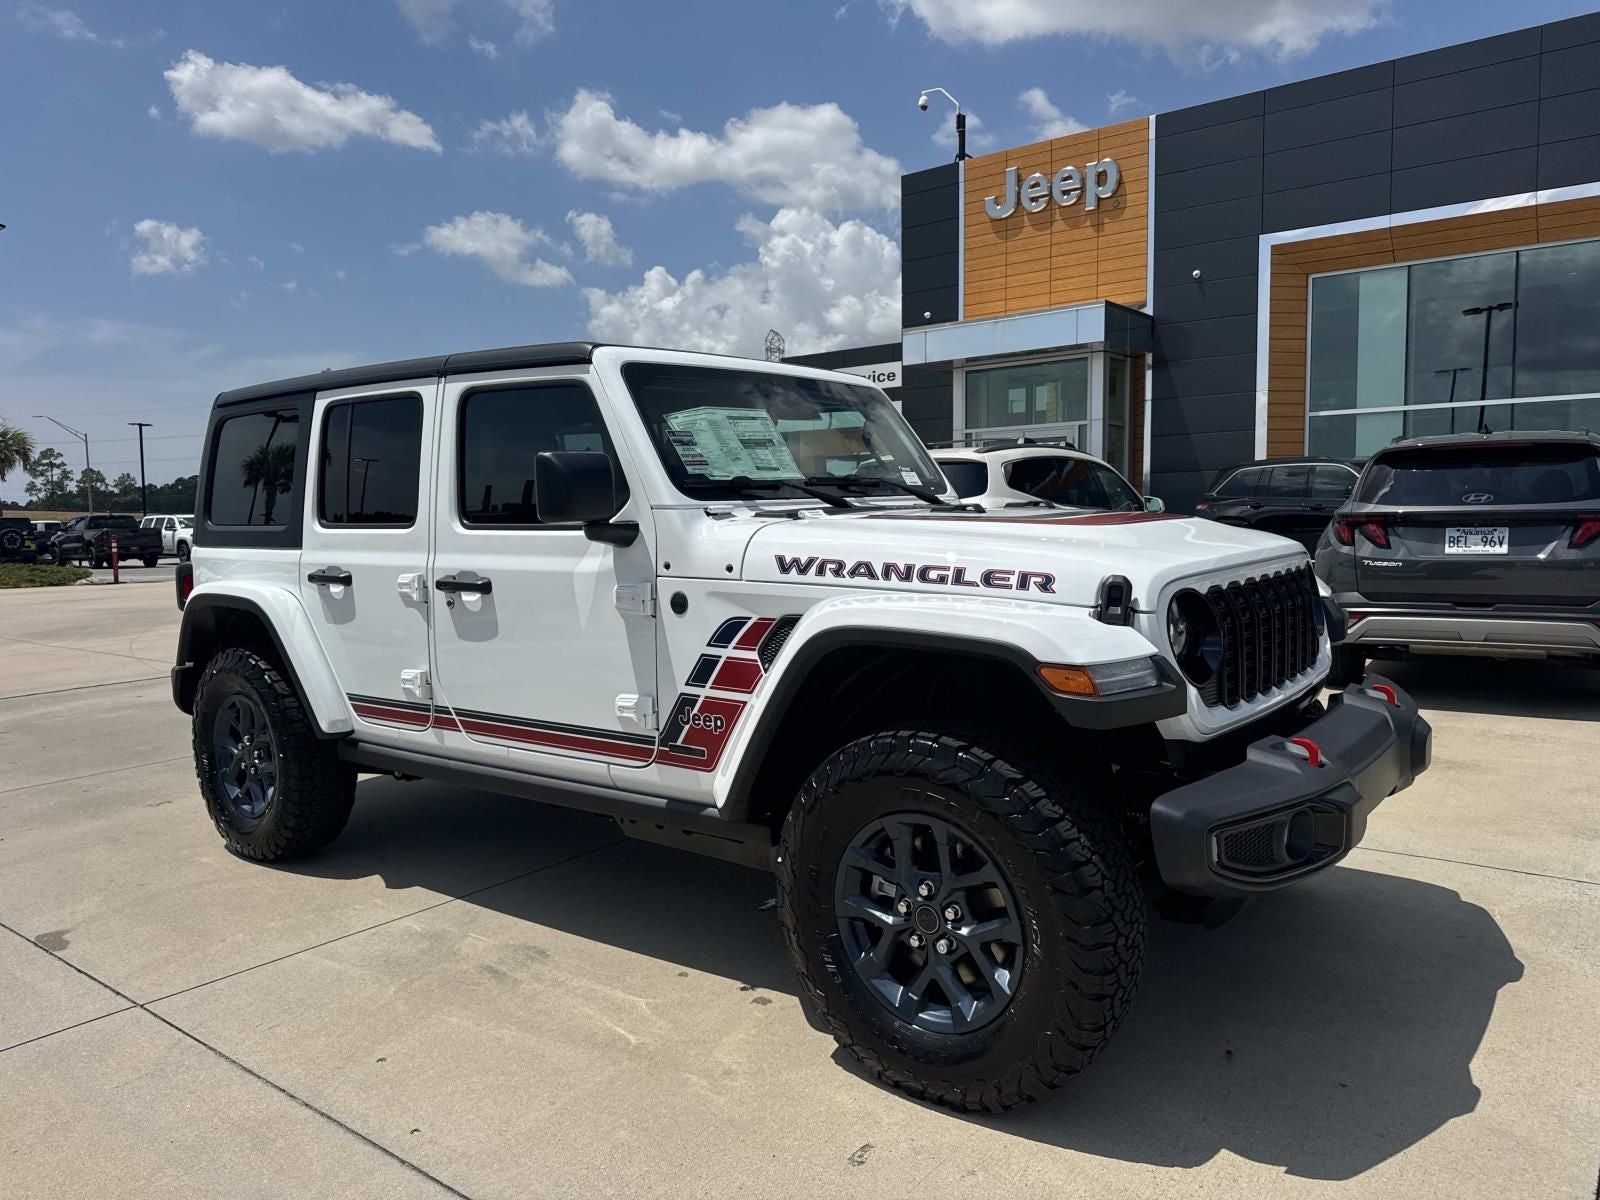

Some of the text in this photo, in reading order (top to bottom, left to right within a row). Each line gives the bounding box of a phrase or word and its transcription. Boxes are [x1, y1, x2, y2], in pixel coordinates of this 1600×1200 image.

[984, 158, 1120, 219] Jeep
[1448, 536, 1505, 548] BEL 96V
[775, 555, 1056, 594] WRANGLER
[678, 707, 726, 735] Jeep
